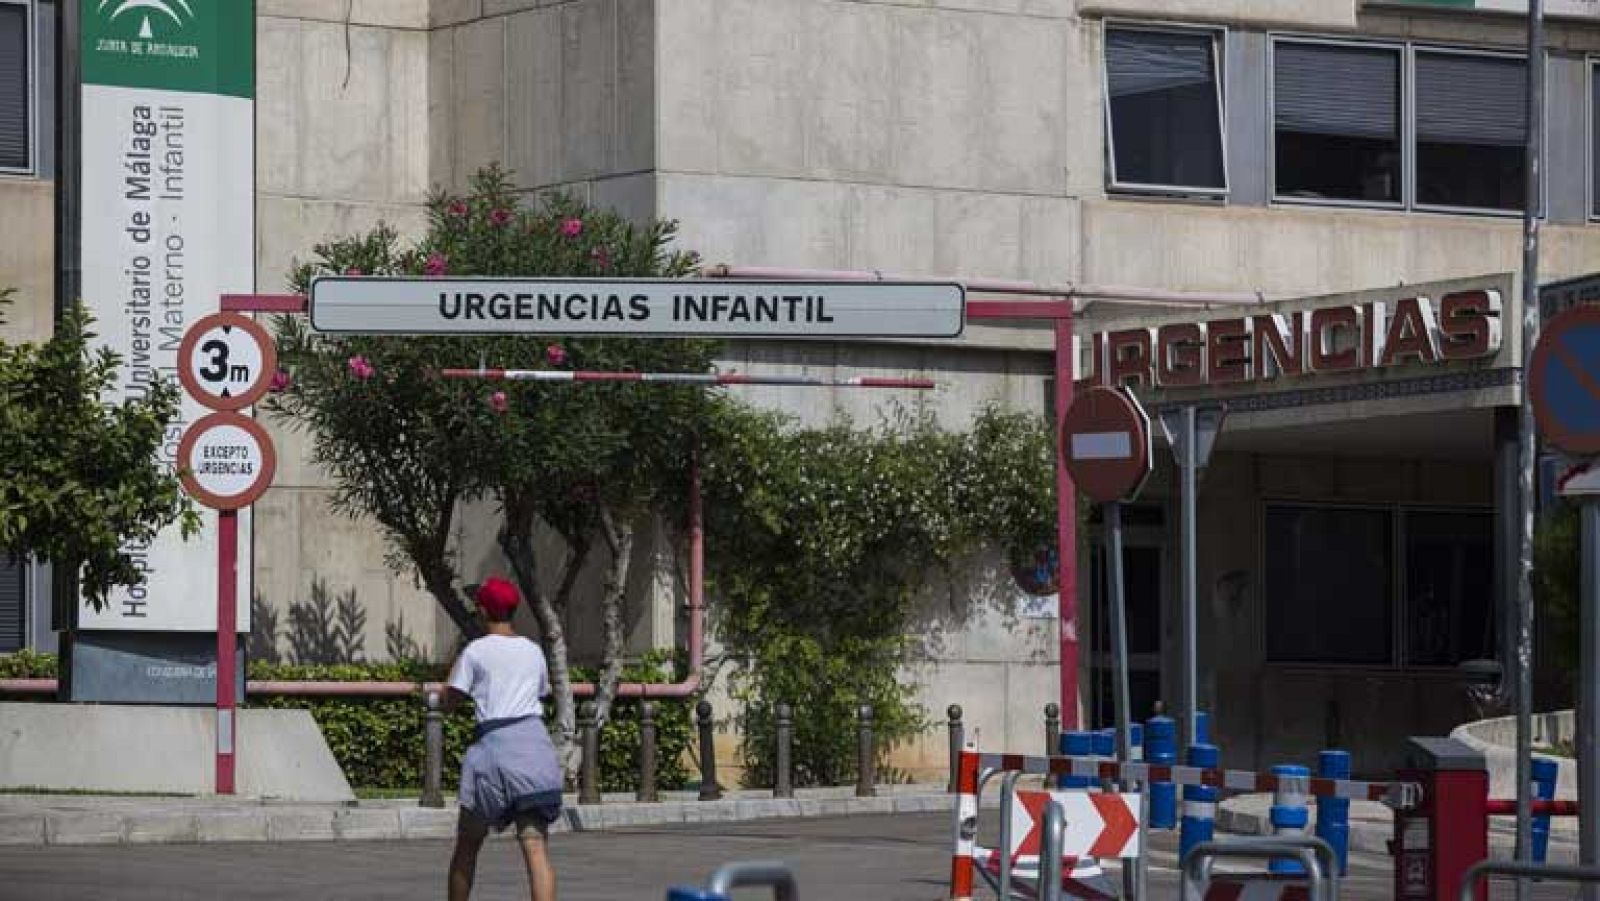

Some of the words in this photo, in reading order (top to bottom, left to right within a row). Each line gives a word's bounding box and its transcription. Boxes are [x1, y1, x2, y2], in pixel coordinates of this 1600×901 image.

[124, 105, 156, 200] Málaga
[159, 107, 184, 200] Infantil
[125, 211, 151, 243] de
[158, 234, 184, 351] Materno
[438, 292, 651, 321] URGENCIAS
[671, 294, 835, 323] INFANTIL
[125, 256, 151, 400] Universitario
[199, 461, 253, 475] URGENCIAS
[203, 445, 249, 460] EXCEPTO
